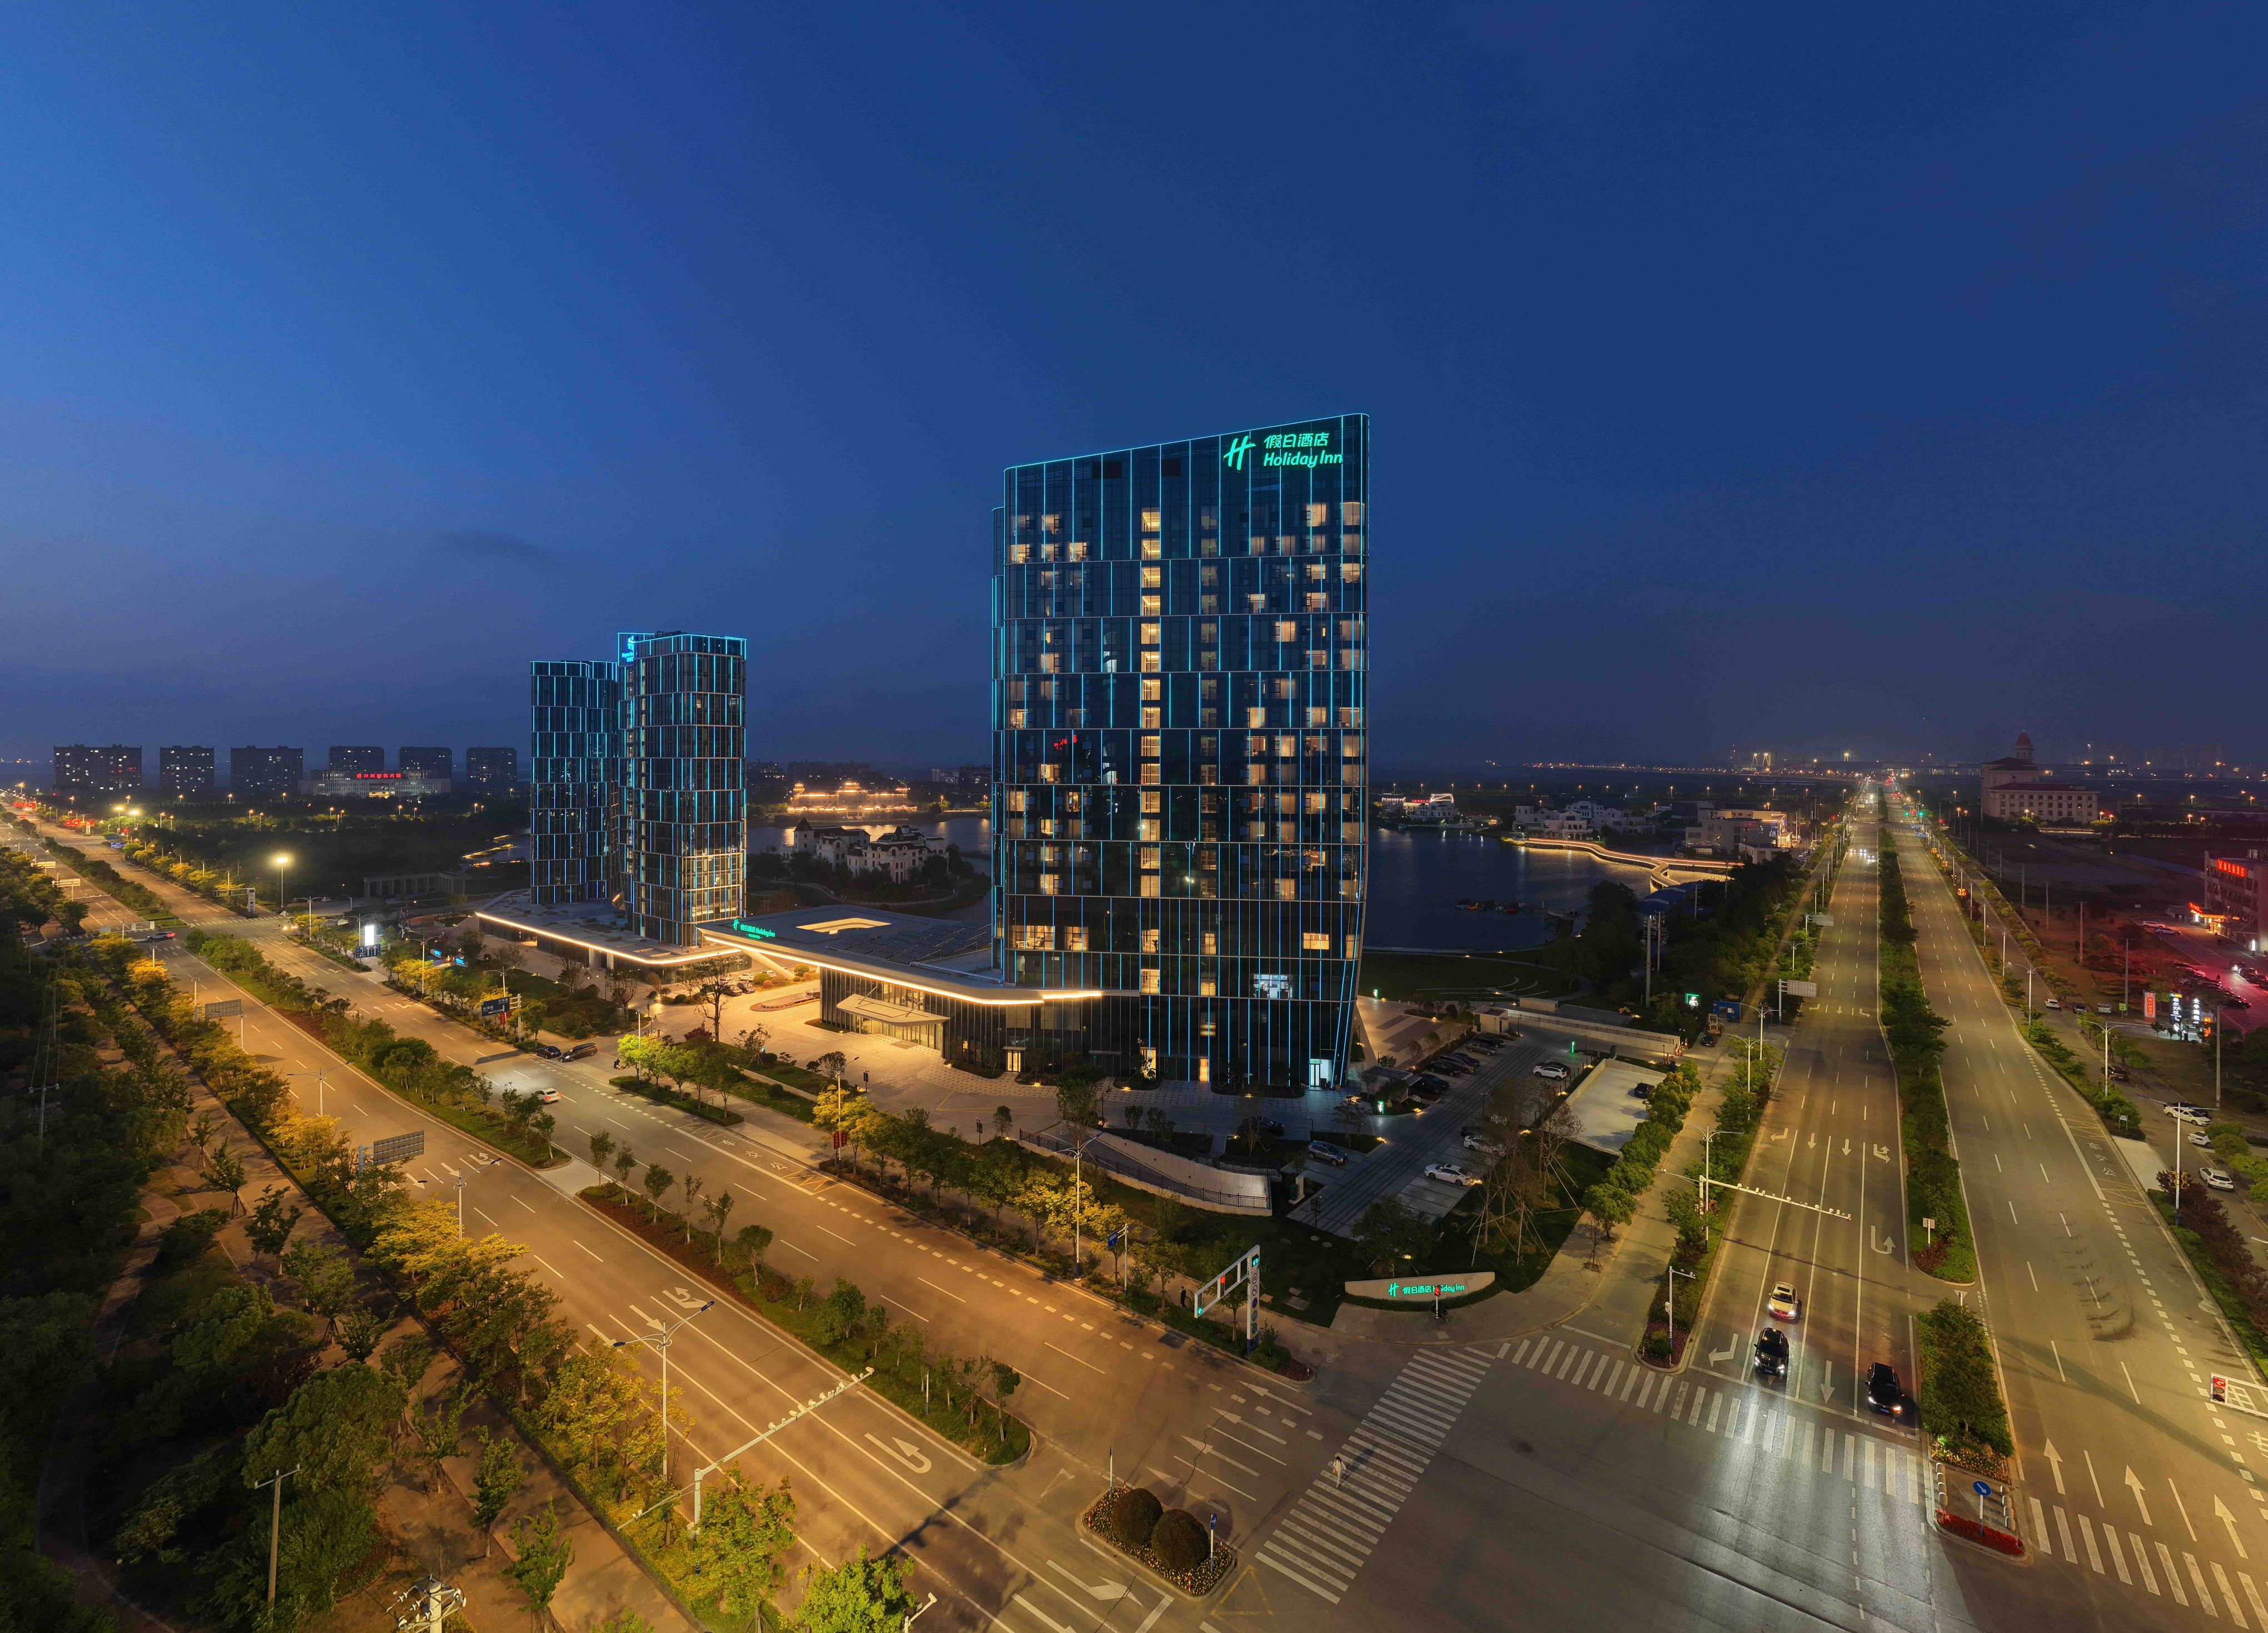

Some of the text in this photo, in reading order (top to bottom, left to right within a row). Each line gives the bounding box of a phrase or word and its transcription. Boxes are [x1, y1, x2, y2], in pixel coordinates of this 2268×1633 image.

[1264, 433, 1329, 449] 假日酒店
[1264, 450, 1342, 468] Holiday Inn
[756, 927, 769, 937] Holiday
[1402, 1285, 1431, 1294] 假日酒店
